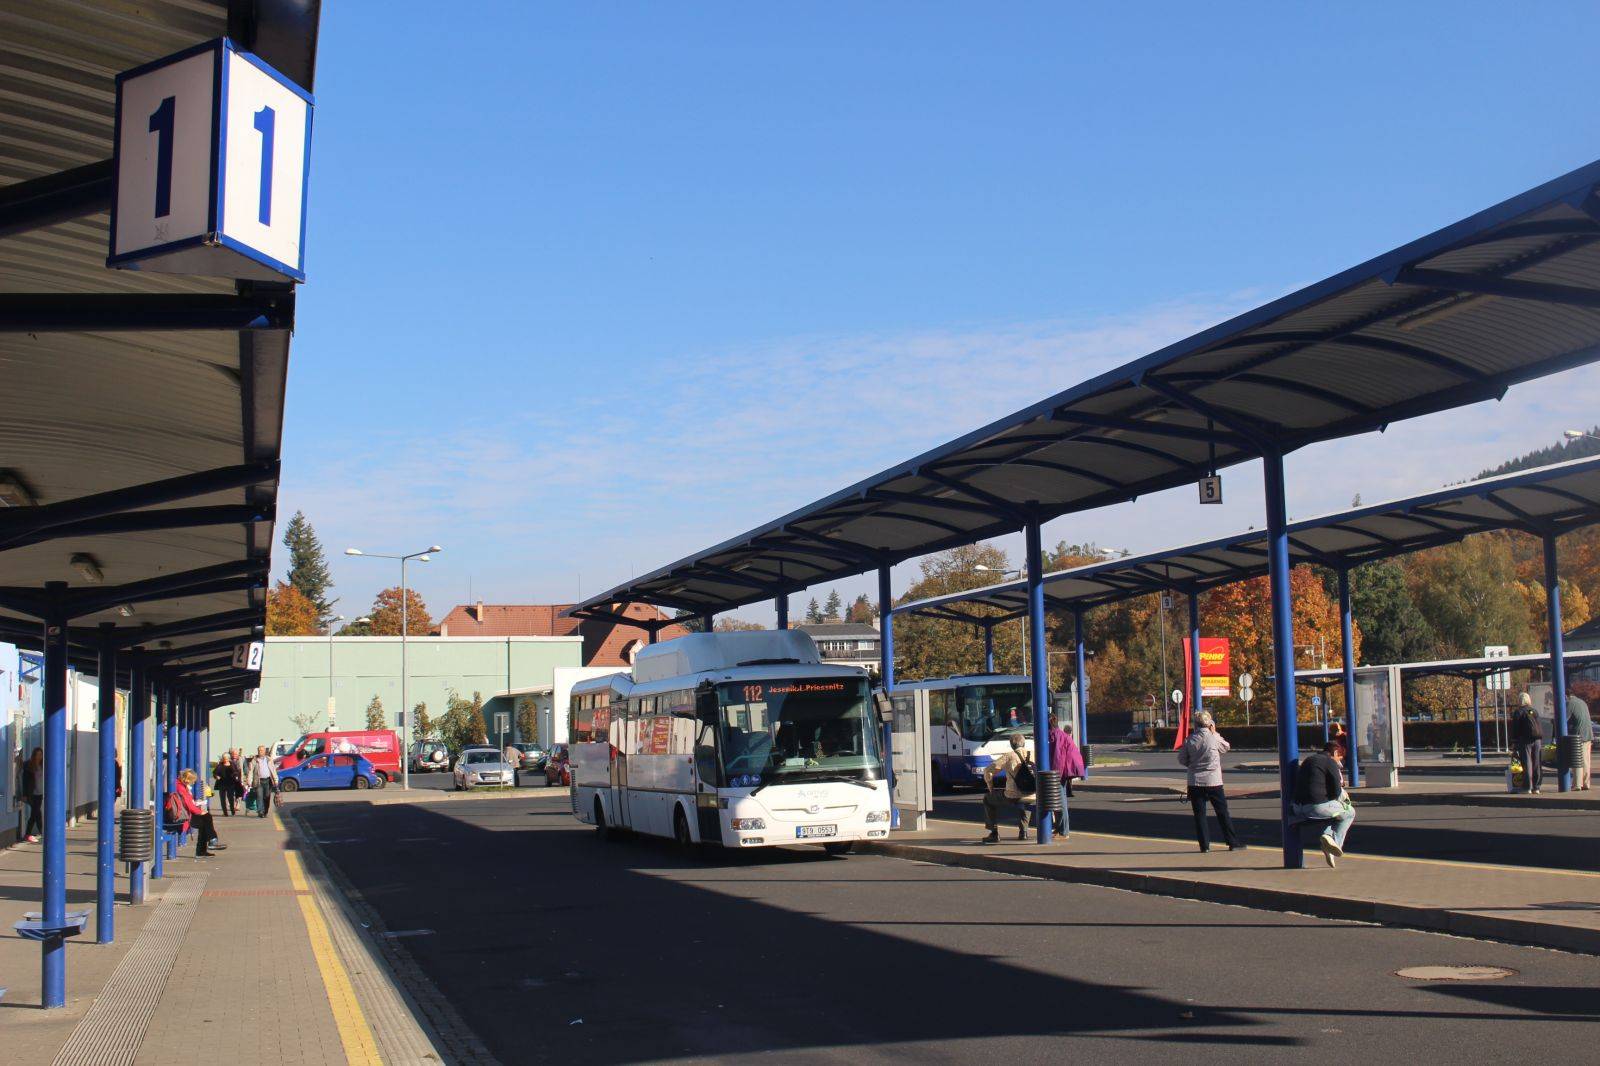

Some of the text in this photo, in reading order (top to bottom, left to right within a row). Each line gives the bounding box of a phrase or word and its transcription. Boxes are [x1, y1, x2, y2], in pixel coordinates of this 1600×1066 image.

[149, 95, 176, 219] 1
[253, 104, 276, 228] 1
[1205, 481, 1214, 498] 5
[238, 646, 245, 663] 2
[251, 647, 259, 665] 2
[743, 685, 763, 701] 112
